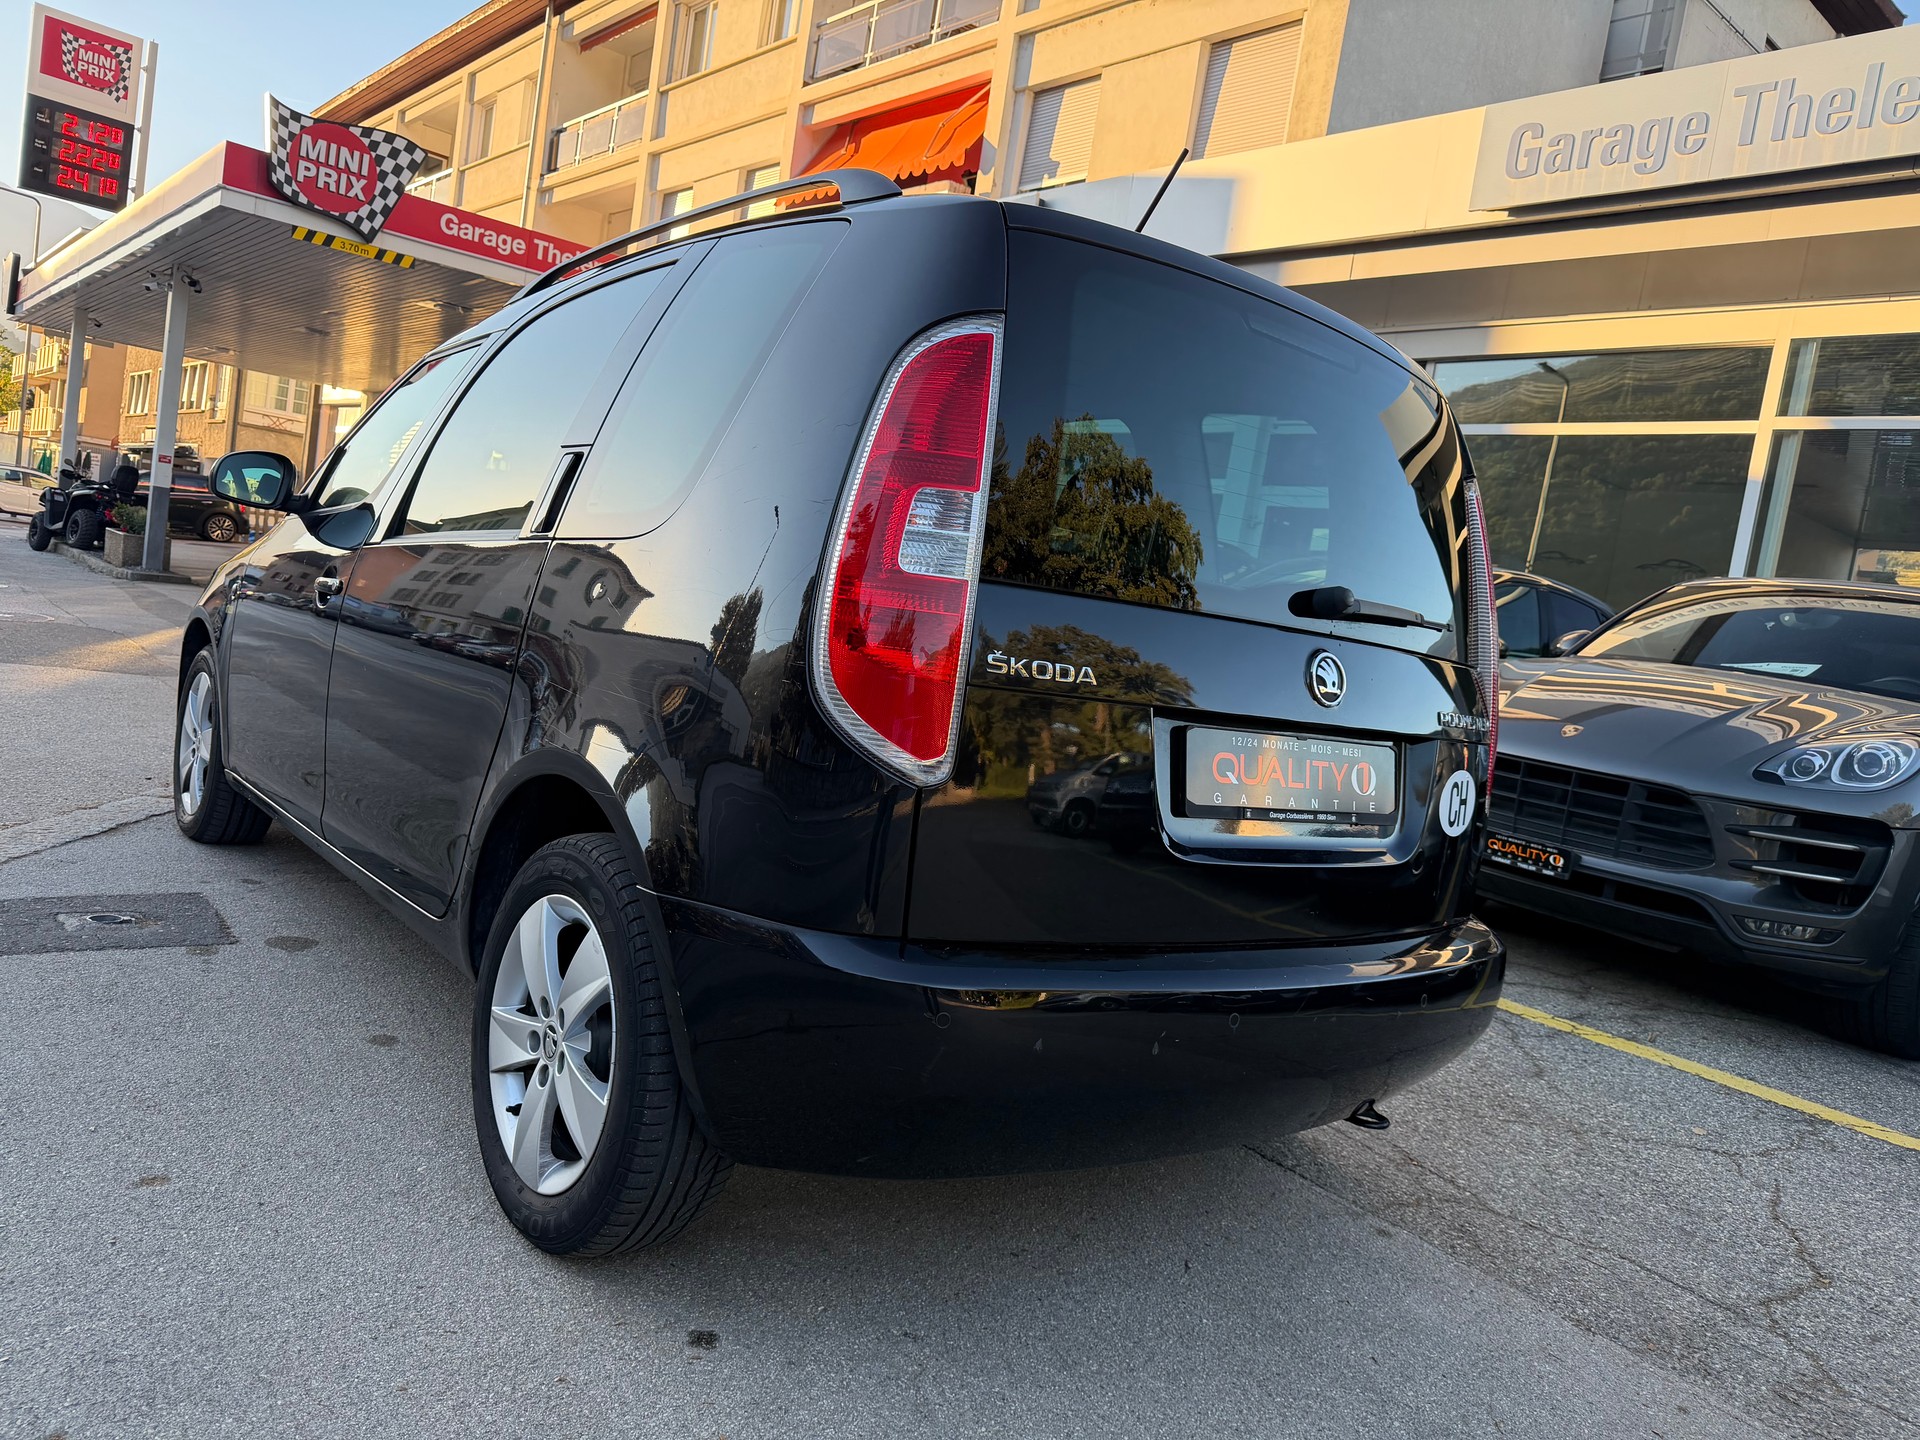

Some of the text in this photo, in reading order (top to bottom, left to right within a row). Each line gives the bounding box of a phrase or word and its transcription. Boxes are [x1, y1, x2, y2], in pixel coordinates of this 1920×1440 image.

[77, 60, 115, 83] PRIX
[78, 48, 116, 70] MINI
[299, 133, 370, 177] MINI
[1504, 111, 1711, 180] Garage
[296, 159, 369, 202] PRIX
[439, 212, 527, 256] Garage
[986, 649, 1097, 686] ŠKODA
[1231, 736, 1258, 747] 12/24
[1262, 739, 1299, 752] MONATE
[1311, 744, 1332, 755] MOIS
[1342, 747, 1362, 758] MESI
[1212, 751, 1349, 793] QUALITY
[1213, 791, 1376, 812] GARANTIE
[1447, 779, 1470, 828] CH
[1487, 838, 1550, 863] QUALITY
